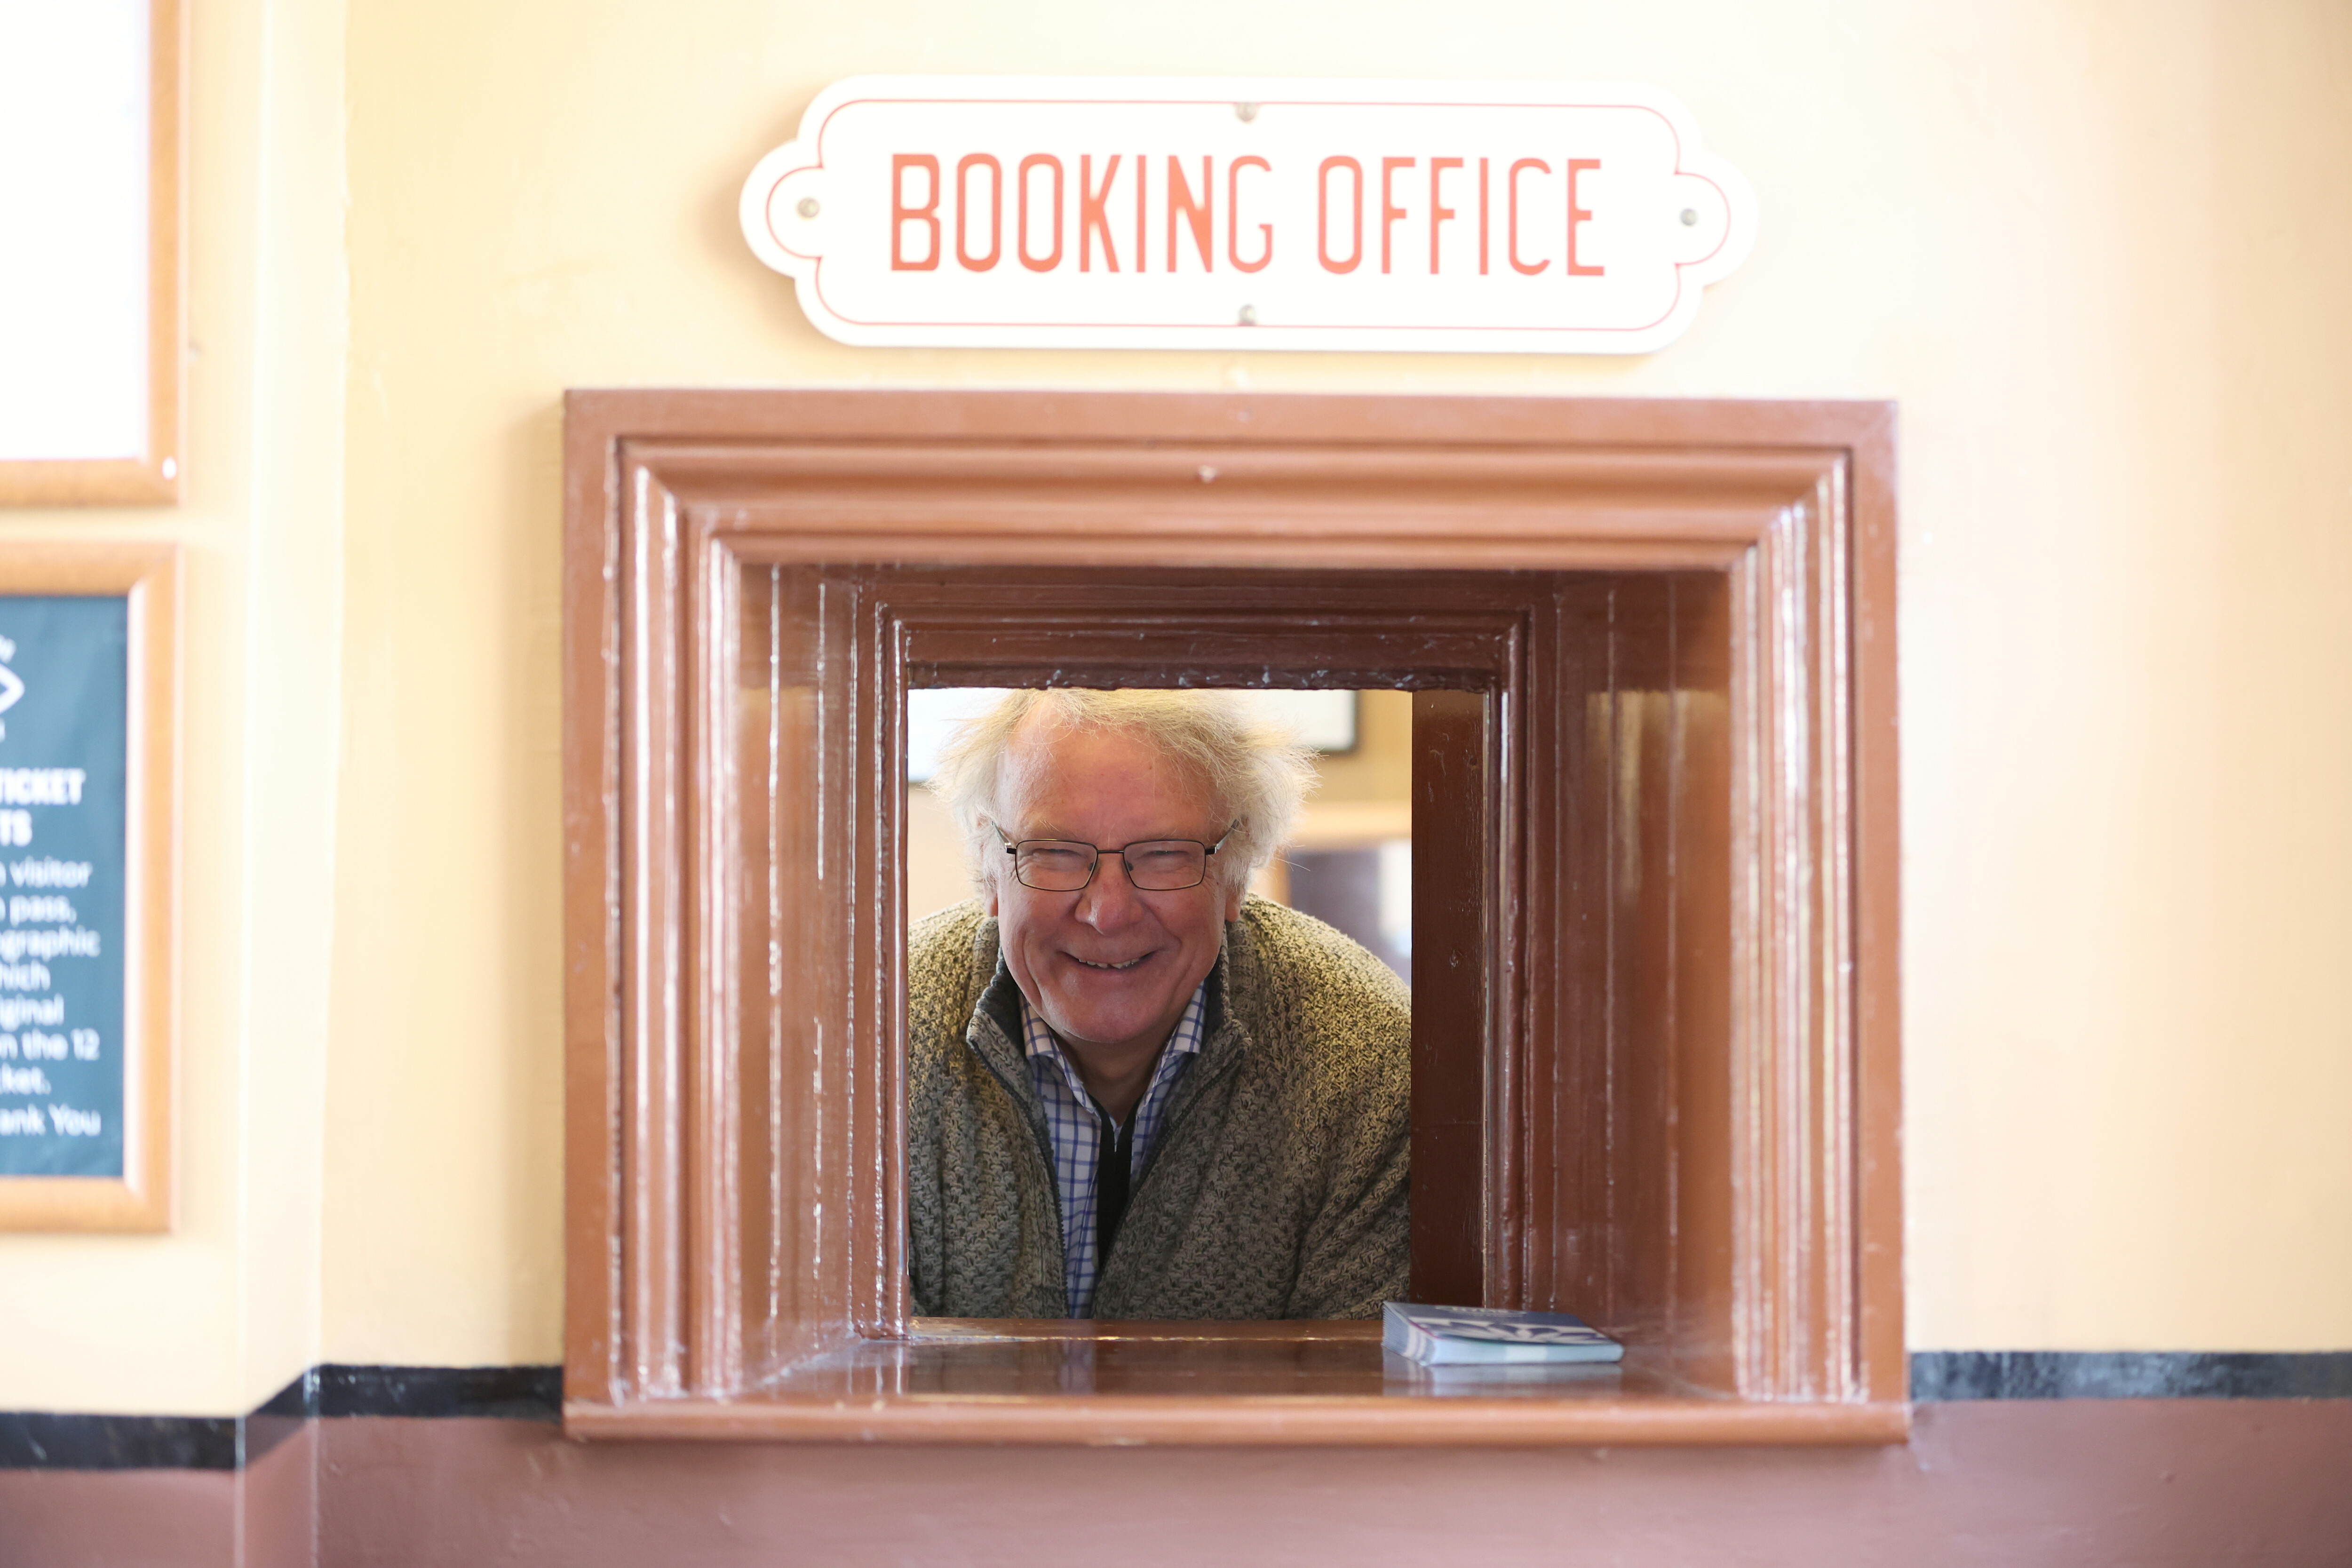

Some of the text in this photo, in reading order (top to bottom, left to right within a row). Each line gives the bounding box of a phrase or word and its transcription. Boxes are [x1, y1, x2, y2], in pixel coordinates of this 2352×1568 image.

[890, 153, 1605, 276] BOOKING OFFICE
[10, 856, 92, 888] visitor
[10, 895, 76, 926] pass,
[0, 925, 101, 963] graphic
[22, 1028, 69, 1060] the
[71, 1028, 100, 1060] 12
[0, 1062, 51, 1094] ket.
[48, 1103, 101, 1136] You
